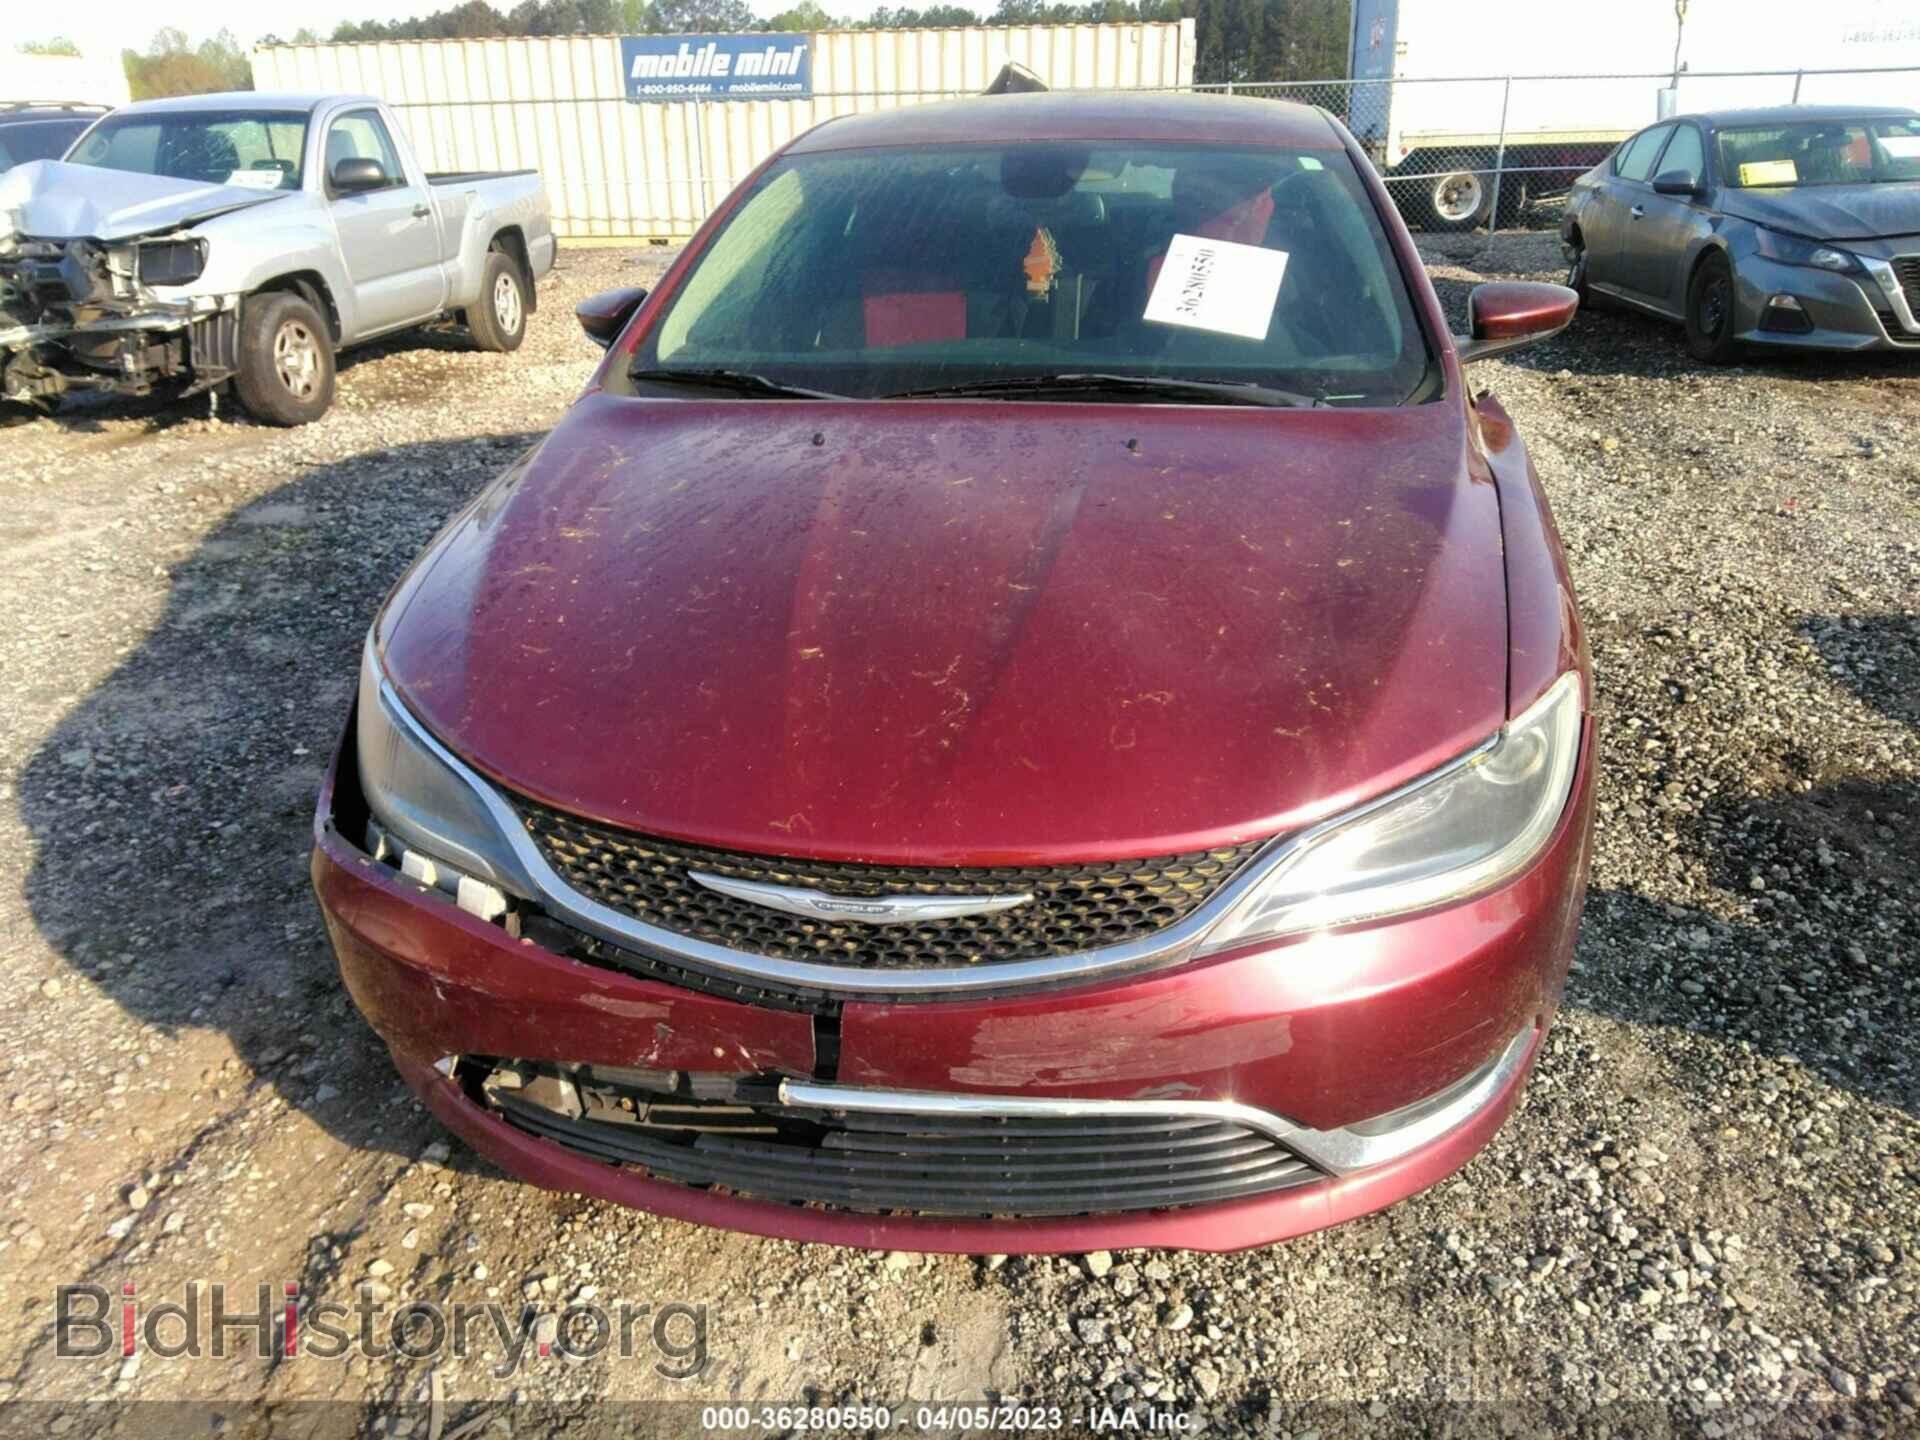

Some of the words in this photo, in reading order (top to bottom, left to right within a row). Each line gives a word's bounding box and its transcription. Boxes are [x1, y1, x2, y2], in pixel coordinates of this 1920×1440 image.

[631, 42, 731, 78] mobile
[734, 45, 803, 76] mini
[728, 81, 802, 93] mobilemini.com
[1176, 248, 1216, 317] 36280550
